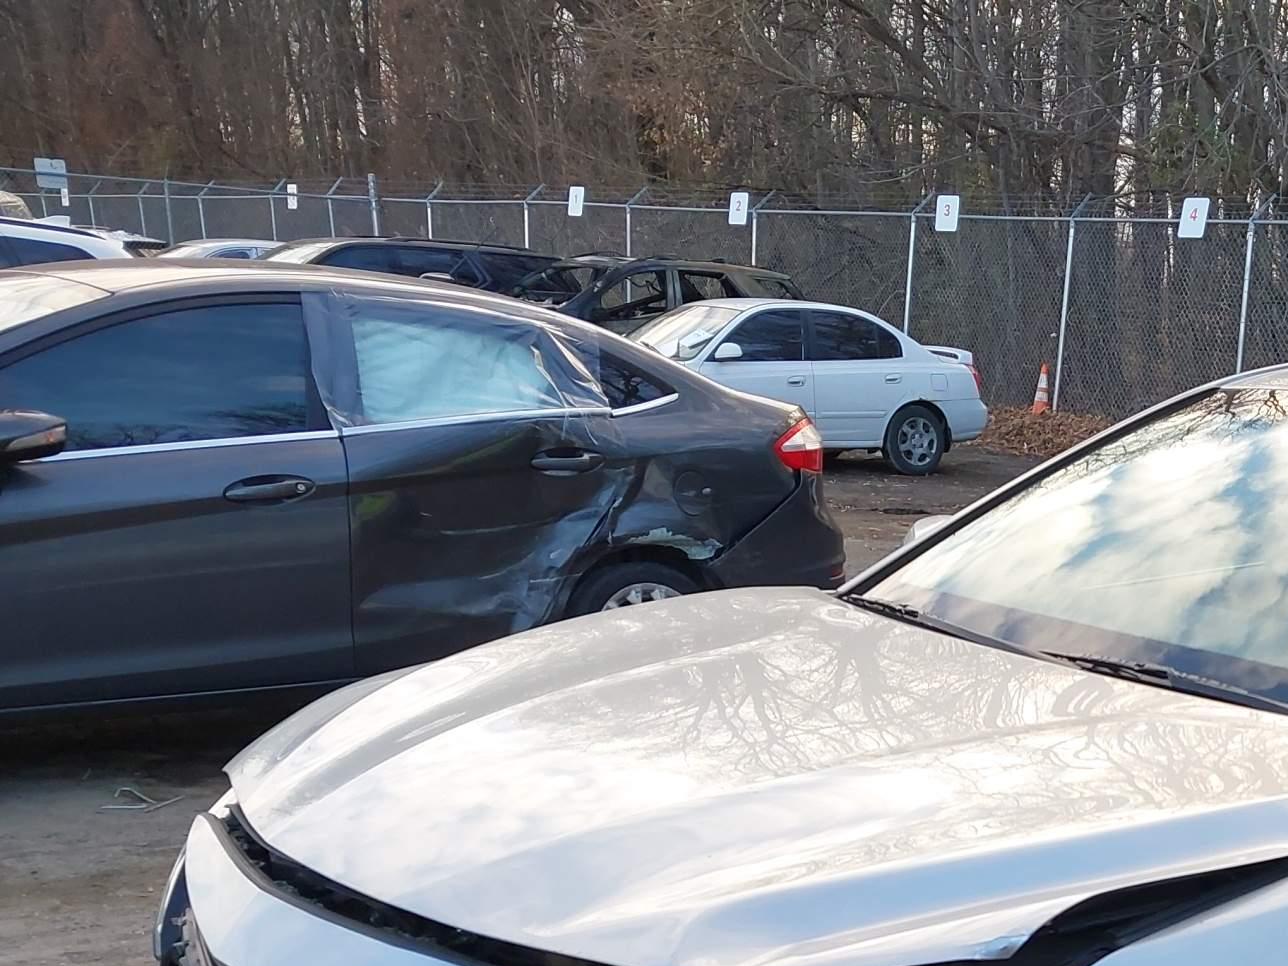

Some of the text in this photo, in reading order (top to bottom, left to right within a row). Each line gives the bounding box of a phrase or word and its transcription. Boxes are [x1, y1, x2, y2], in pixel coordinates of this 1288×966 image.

[735, 200, 742, 212] 2
[943, 204, 951, 217] 3
[1189, 207, 1199, 222] 4
